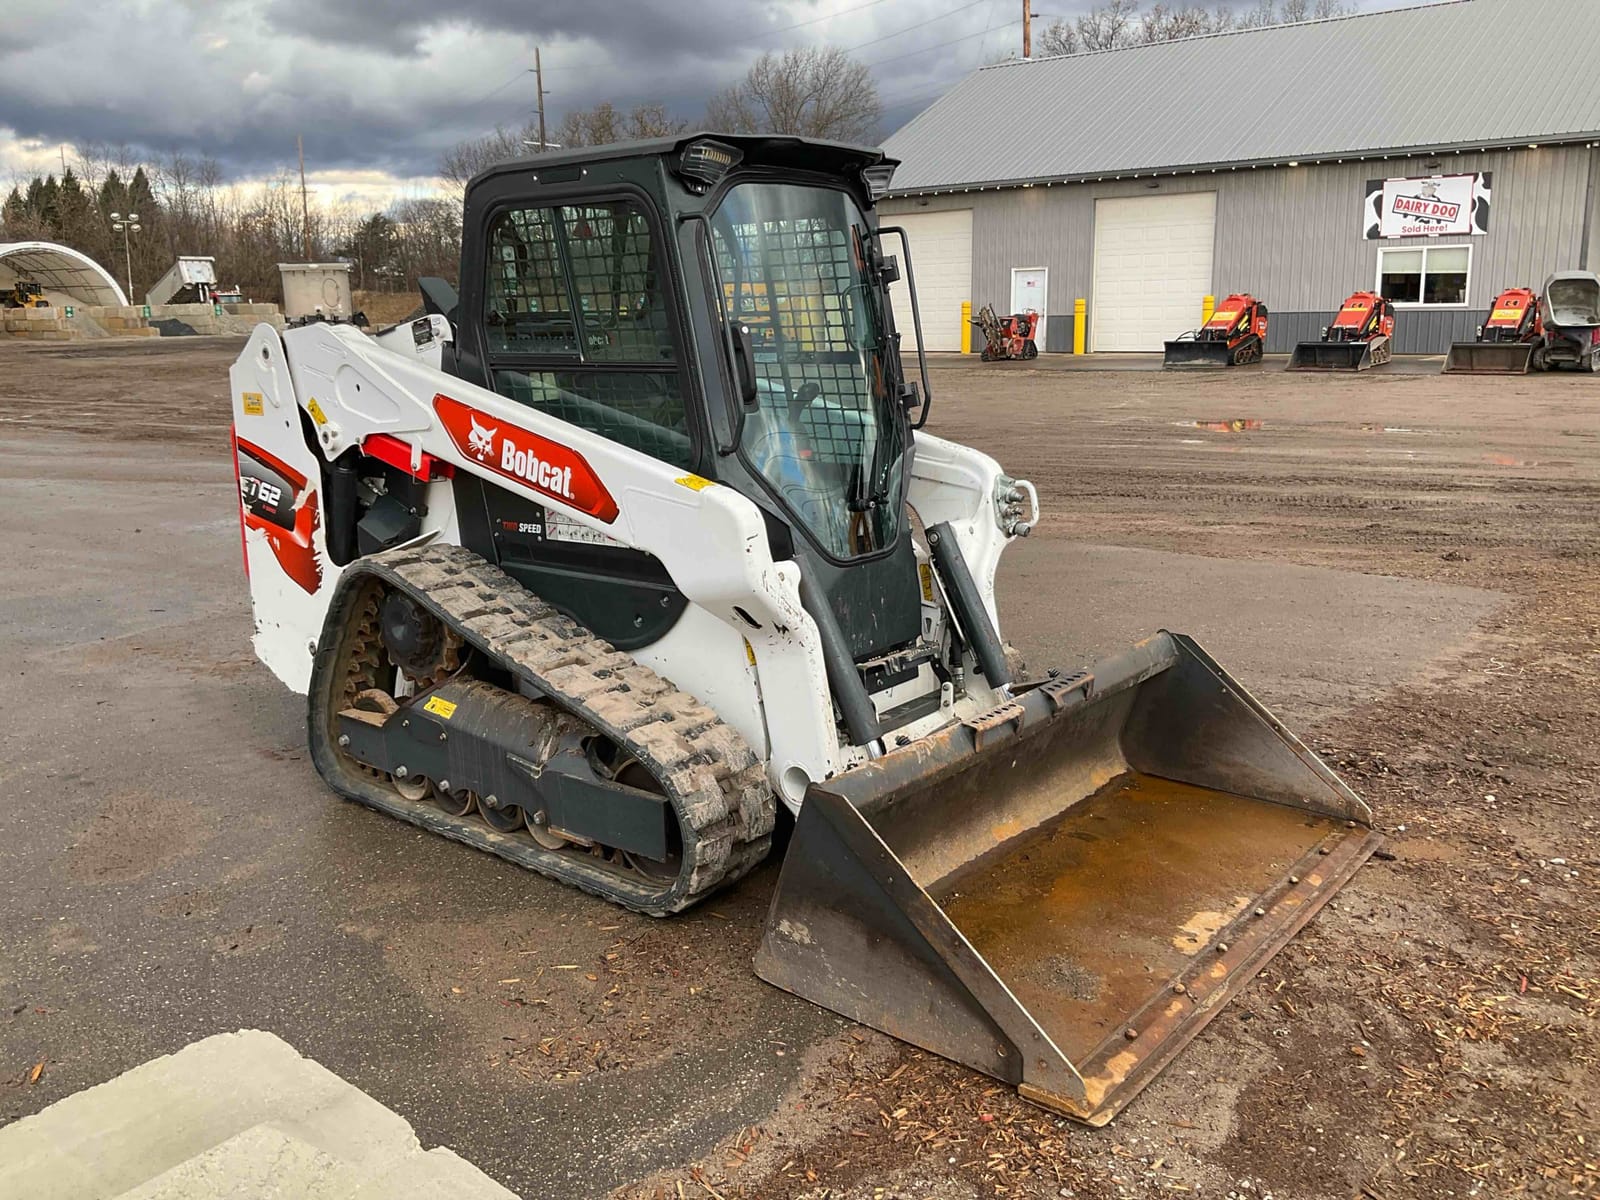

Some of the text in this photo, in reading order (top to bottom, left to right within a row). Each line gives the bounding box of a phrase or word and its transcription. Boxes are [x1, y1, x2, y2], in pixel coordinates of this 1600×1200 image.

[1395, 198, 1457, 217] DAIRY DOO
[1401, 224, 1448, 233] Sold Here!
[501, 438, 572, 498] Bobcat
[518, 522, 542, 534] SPEED
